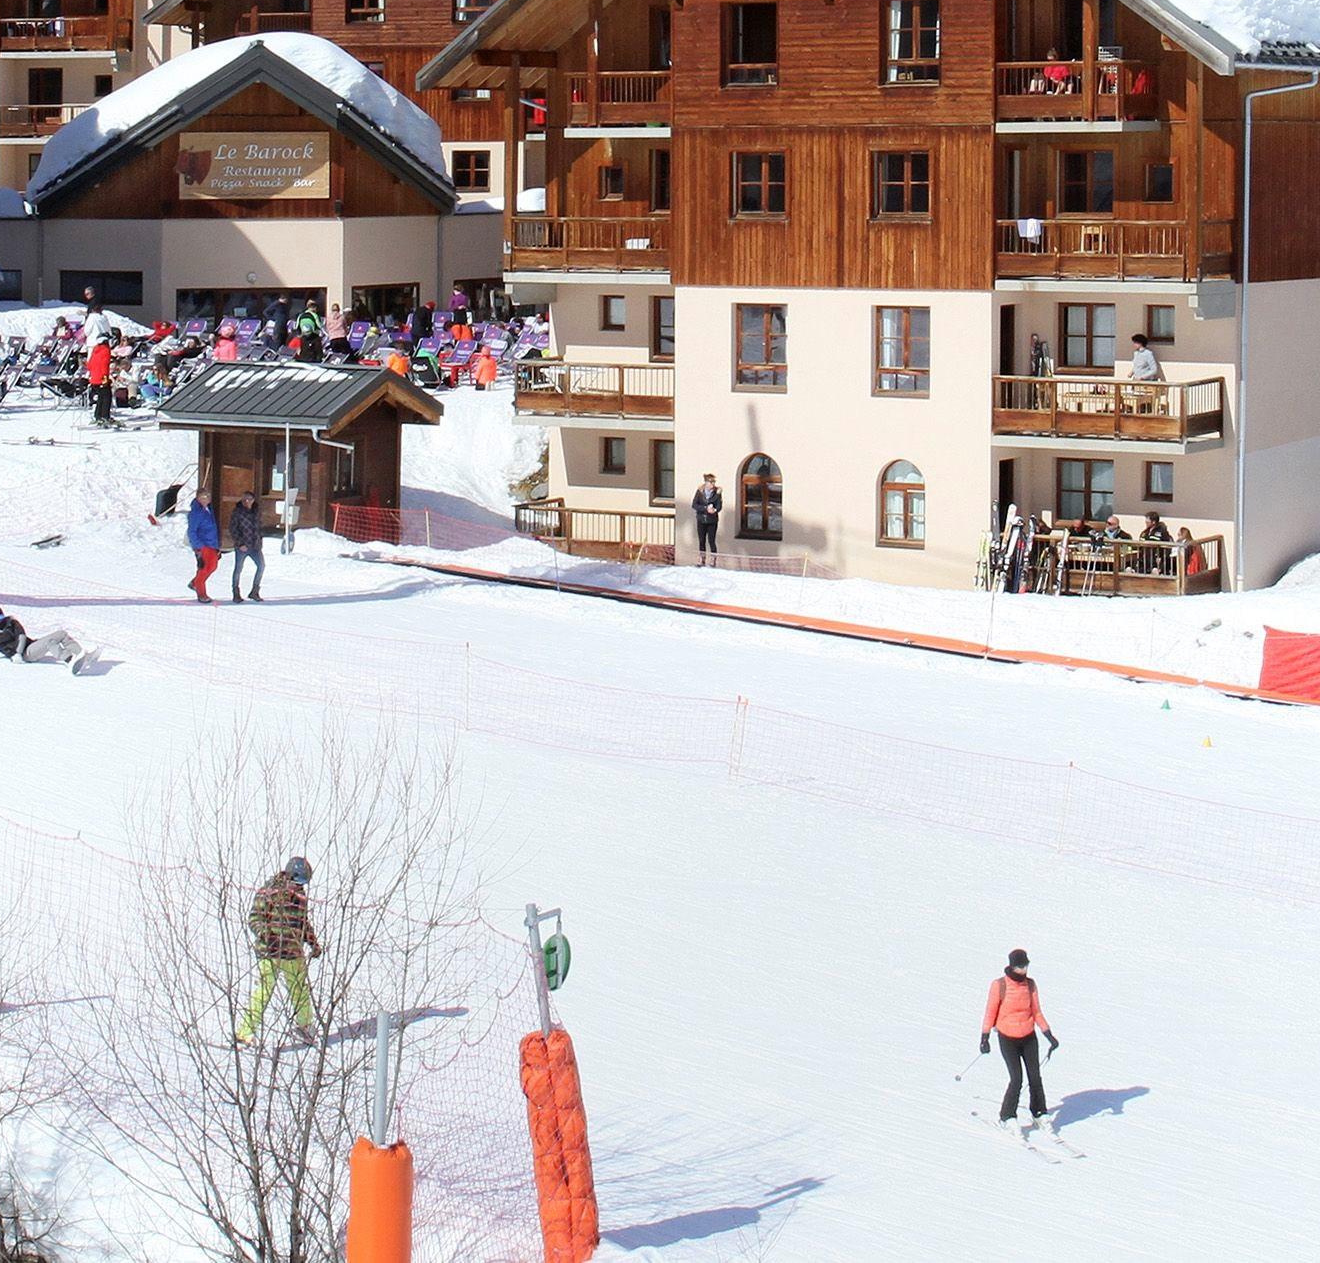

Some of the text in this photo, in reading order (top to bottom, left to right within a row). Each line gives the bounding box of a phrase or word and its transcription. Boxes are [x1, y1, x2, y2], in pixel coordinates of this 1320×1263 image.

[214, 141, 314, 160] Le Barock
[223, 165, 302, 177] Restaurant
[210, 177, 317, 190] Pizza Snack Bar
